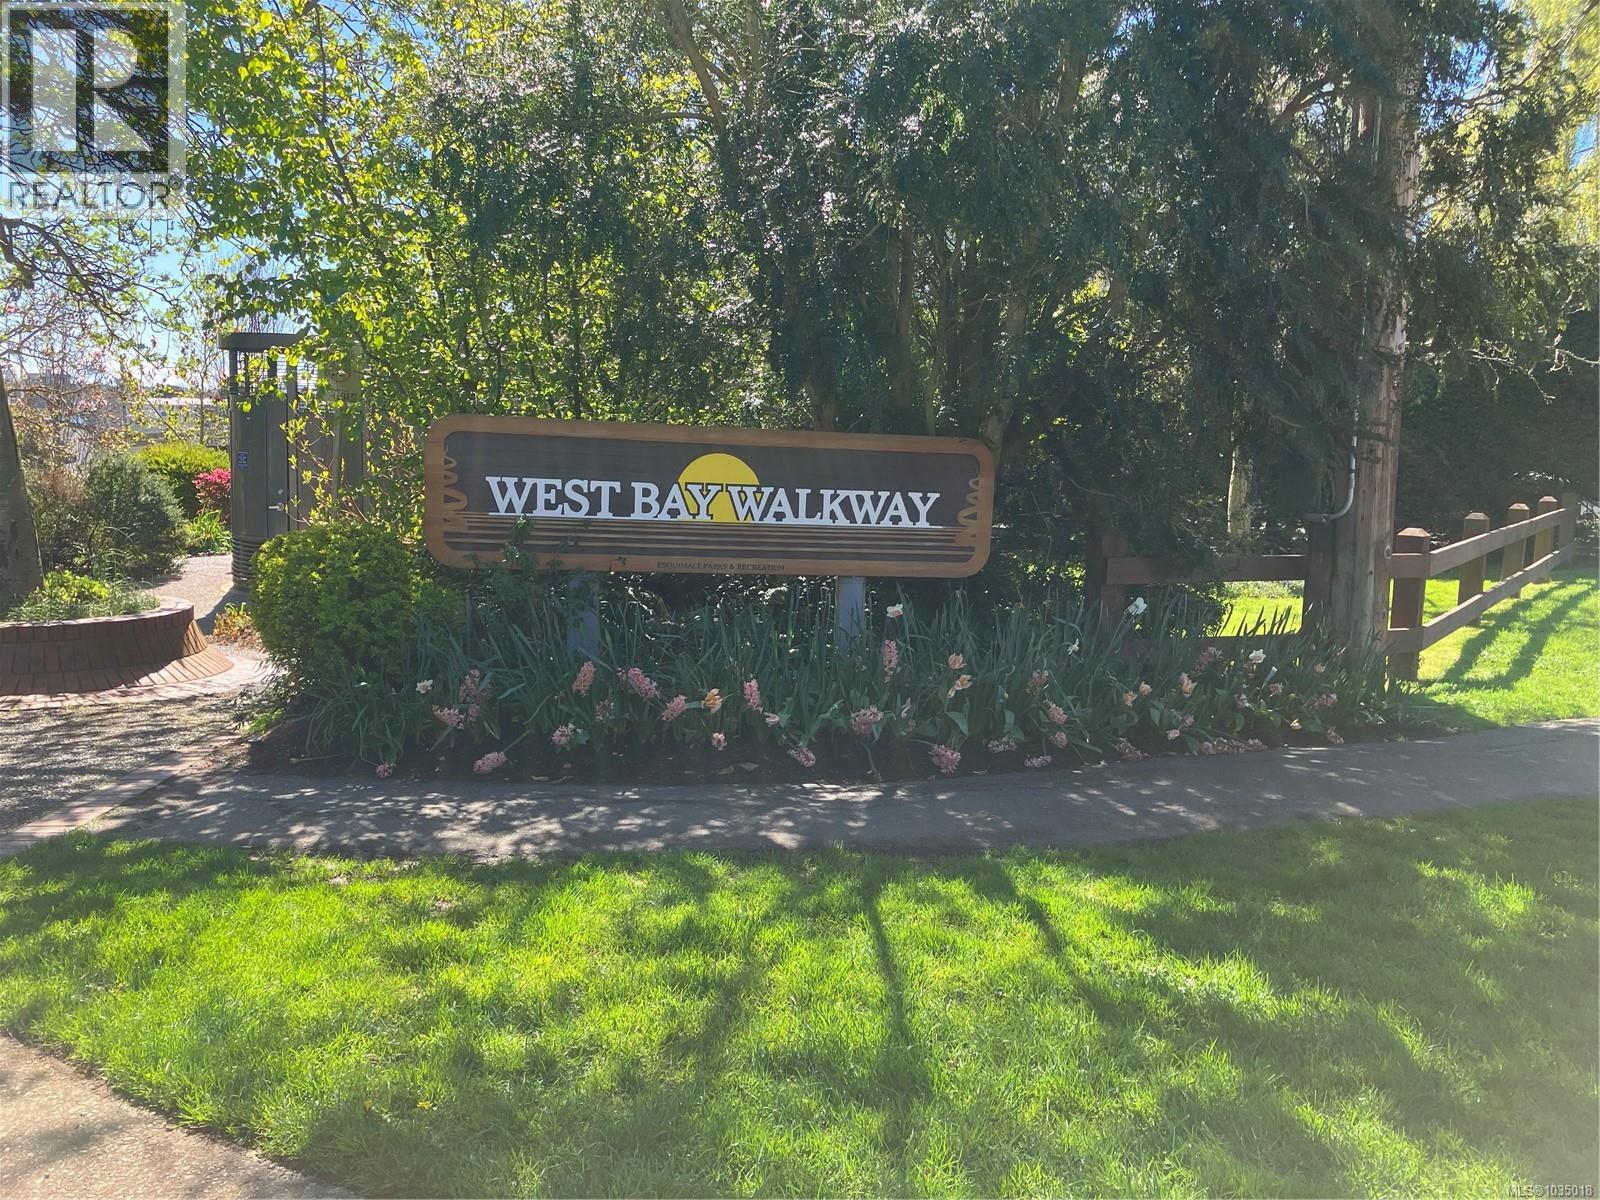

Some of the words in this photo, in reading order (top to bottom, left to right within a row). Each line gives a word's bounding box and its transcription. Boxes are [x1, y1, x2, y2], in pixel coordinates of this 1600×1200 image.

[485, 476, 622, 518] WEST
[630, 481, 720, 521] BAY
[727, 486, 941, 527] WALKWAY
[656, 561, 701, 570] ESQUIMALT
[703, 562, 728, 571] PARKS
[738, 563, 785, 571] RECREATION
